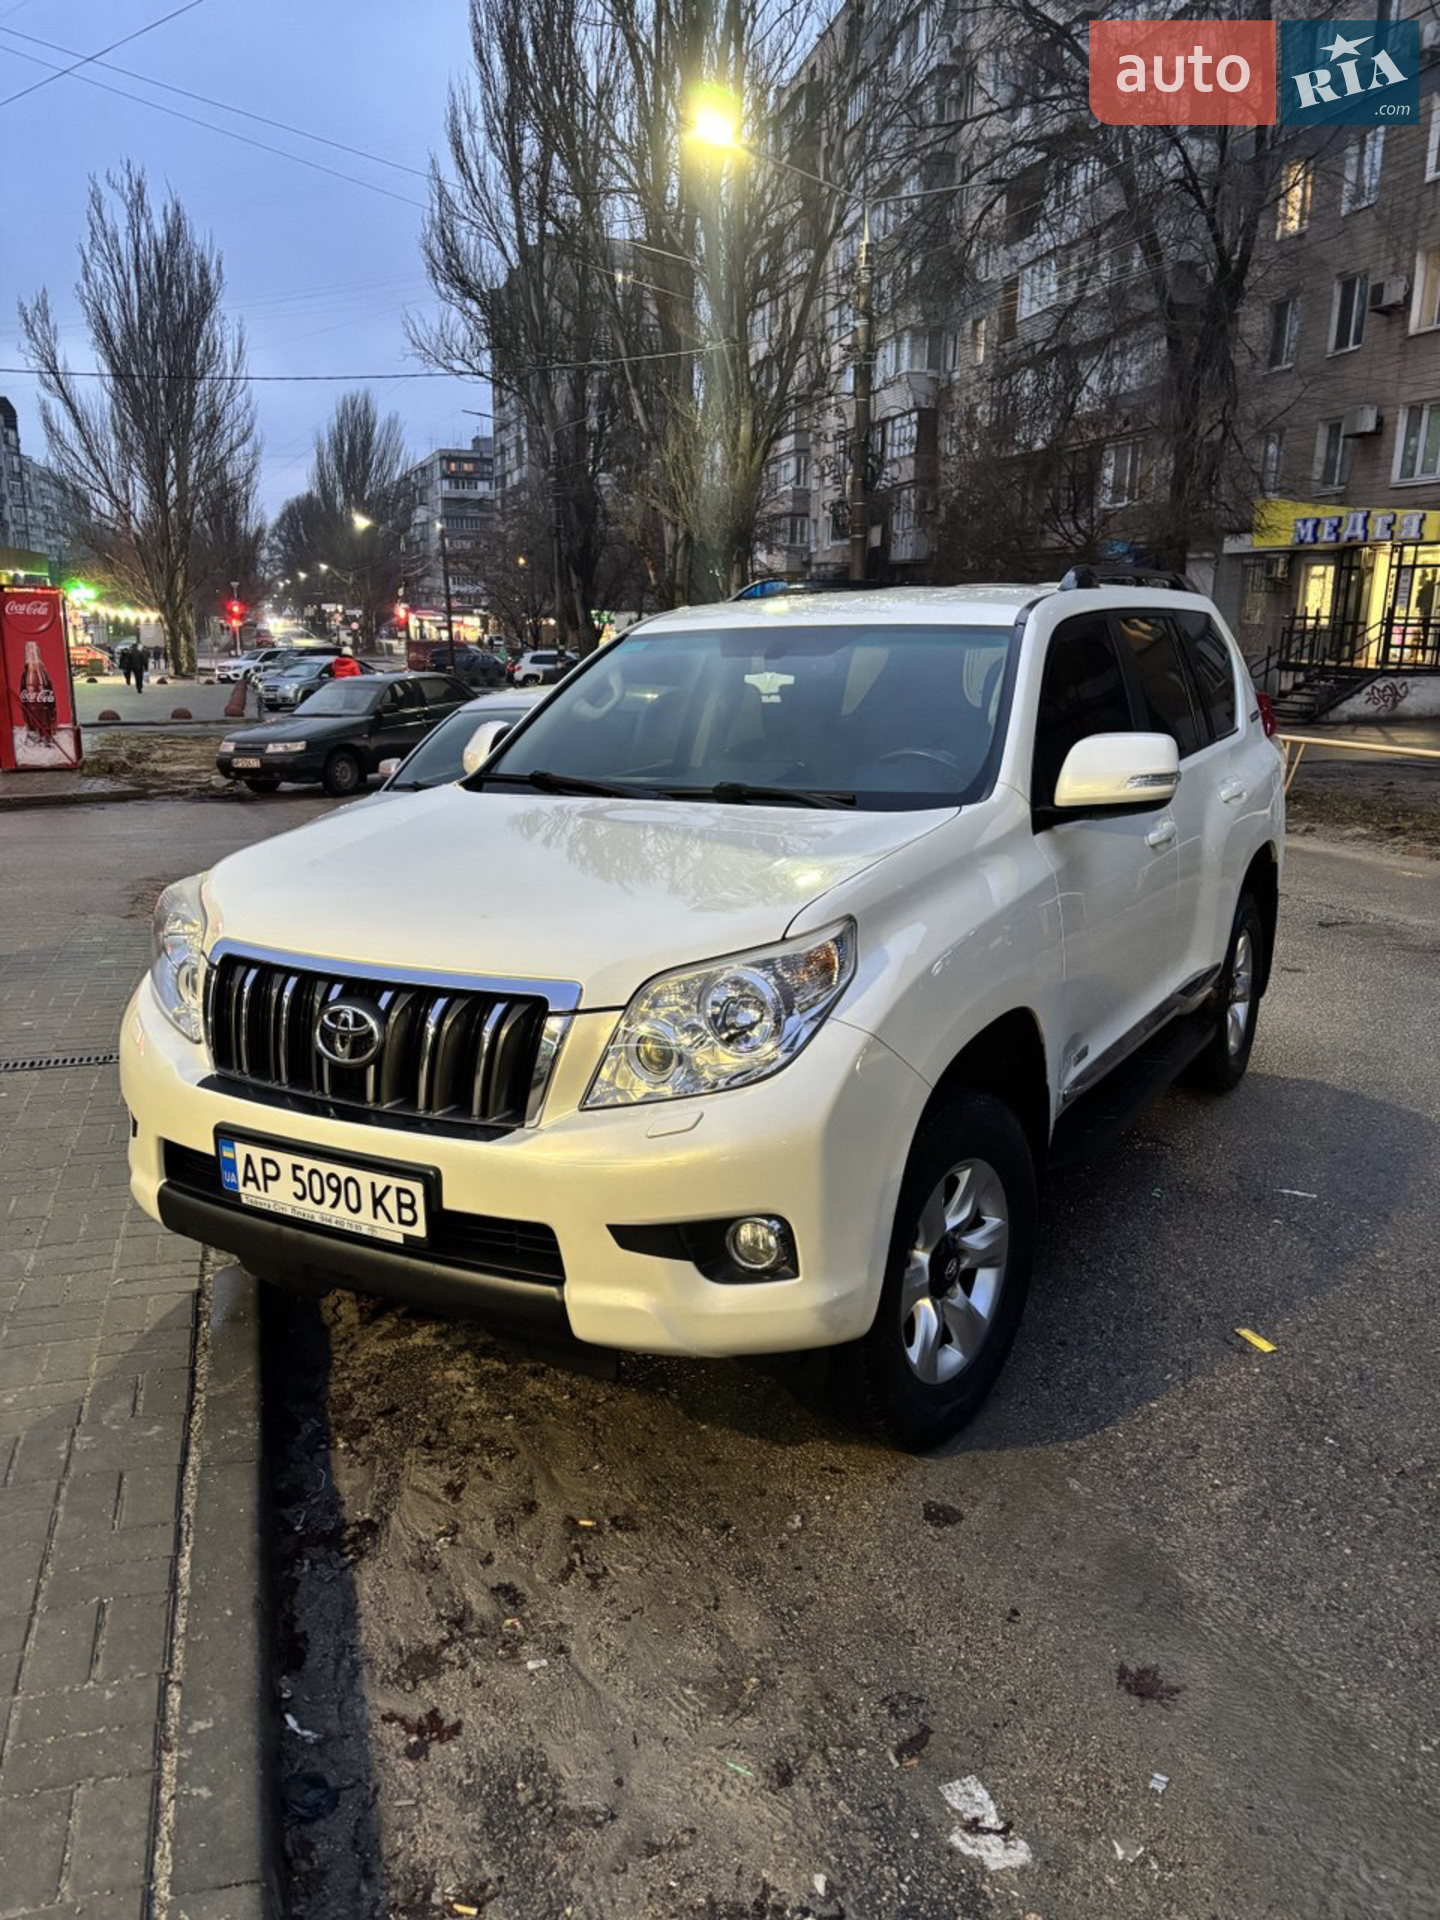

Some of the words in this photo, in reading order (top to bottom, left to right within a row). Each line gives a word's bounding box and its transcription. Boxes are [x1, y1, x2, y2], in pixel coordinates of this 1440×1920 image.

[1294, 510, 1426, 544] МЕДЕЯ
[224, 1171, 238, 1183] UA
[242, 1153, 281, 1194] AP
[291, 1163, 362, 1215] 5090
[370, 1181, 418, 1228] KB
